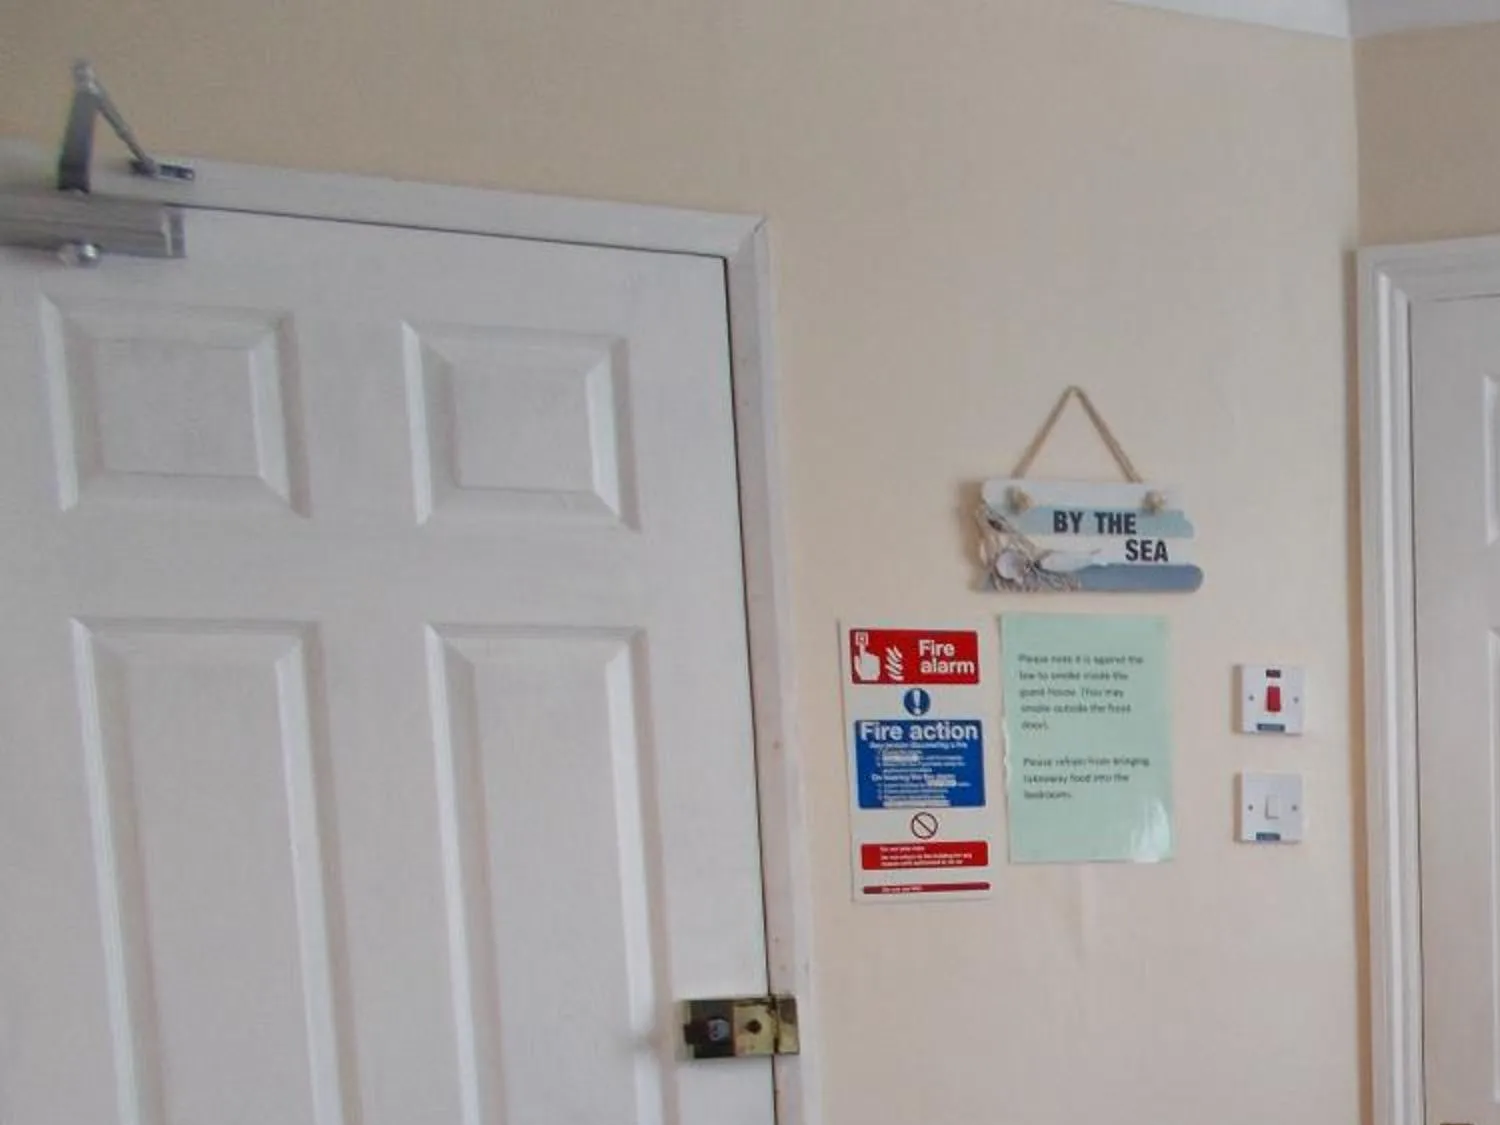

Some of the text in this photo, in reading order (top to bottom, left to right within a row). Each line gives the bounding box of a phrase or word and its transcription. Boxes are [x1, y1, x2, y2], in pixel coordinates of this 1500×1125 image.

[1053, 510, 1137, 534] BY THE
[1125, 539, 1169, 562] SEA
[918, 639, 955, 656] Fire
[920, 659, 975, 675] alarm
[860, 721, 979, 741] Fire action
